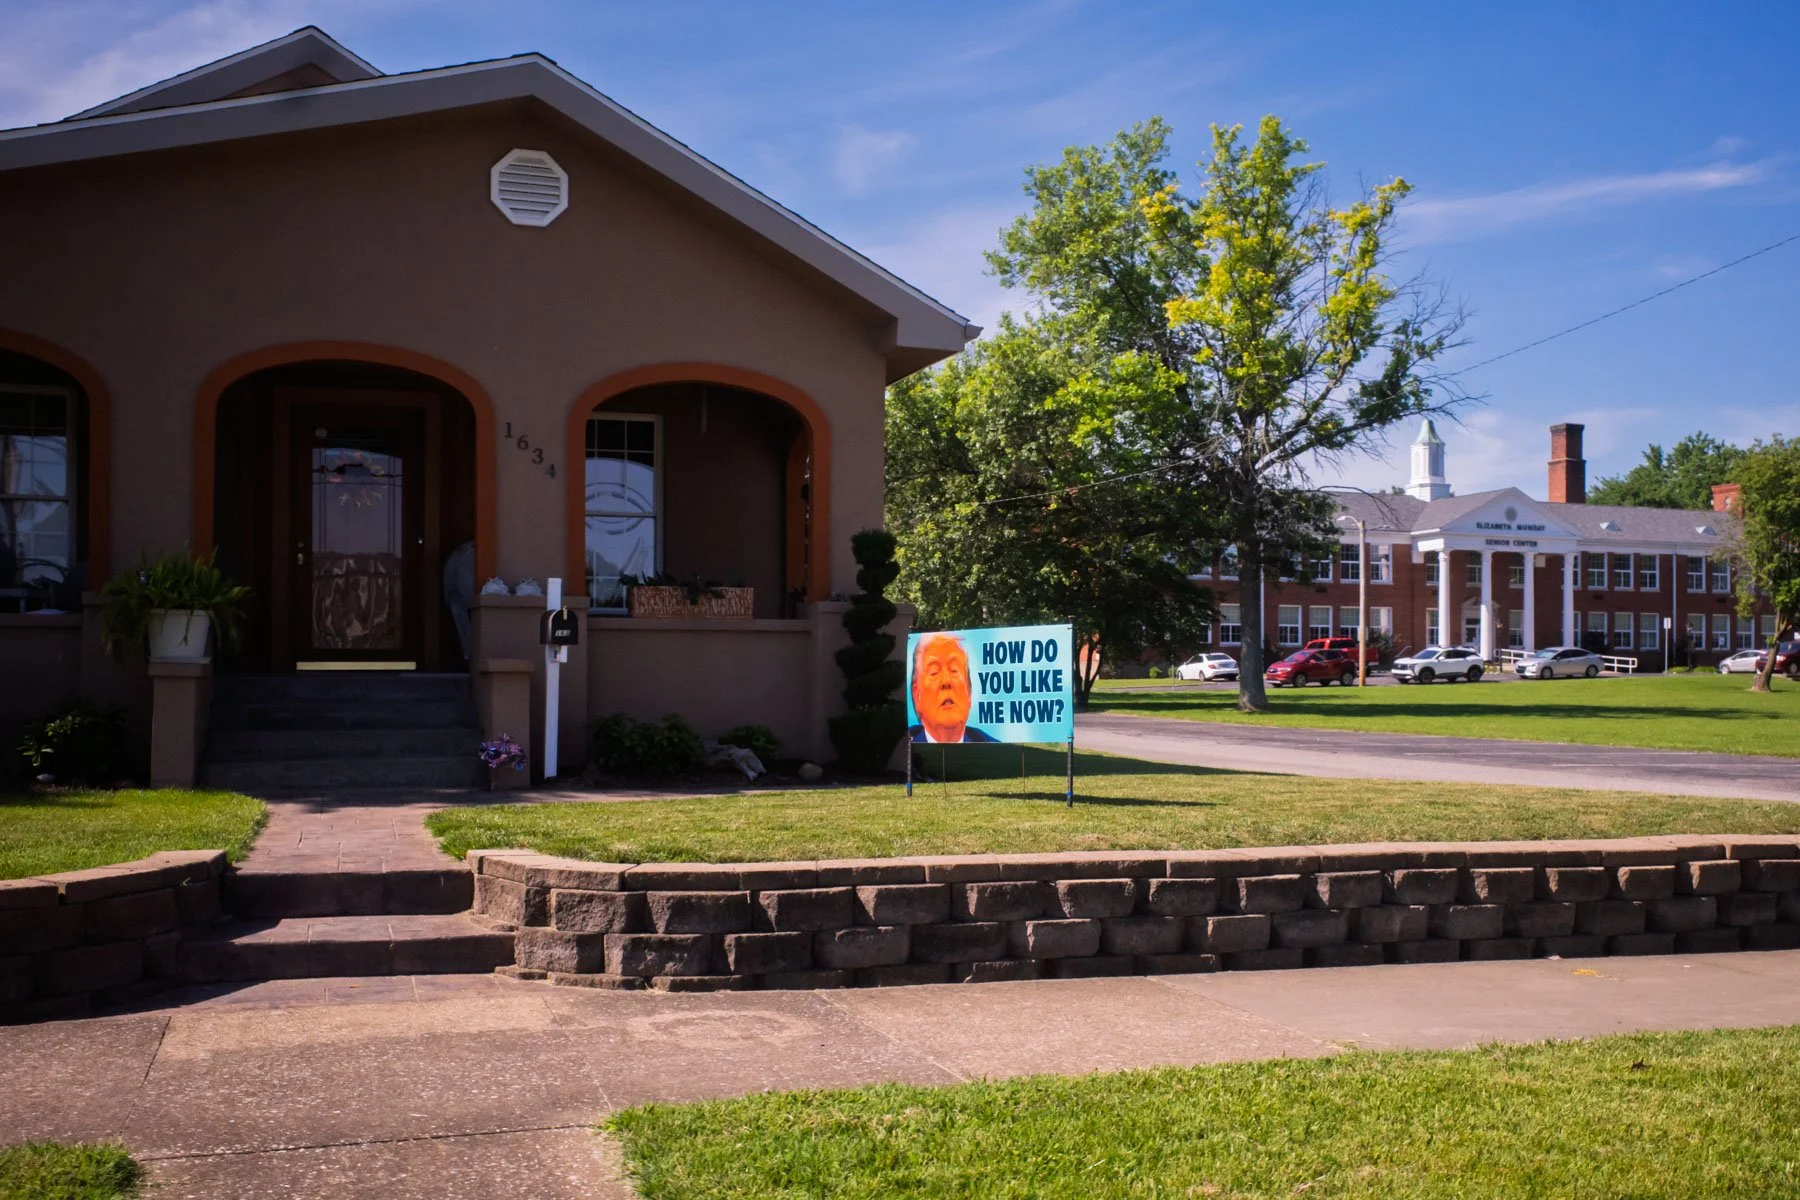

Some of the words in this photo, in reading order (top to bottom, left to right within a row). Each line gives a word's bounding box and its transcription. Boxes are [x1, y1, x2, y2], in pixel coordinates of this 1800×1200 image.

[505, 422, 557, 479] 1634
[1476, 521, 1512, 530] ELIZABETH
[982, 640, 1026, 665] HOW
[1031, 639, 1058, 663] DO
[978, 671, 1015, 695] YOU
[1021, 669, 1063, 693] LIKE
[978, 701, 1004, 724] ME
[1010, 699, 1065, 724] NOW?
